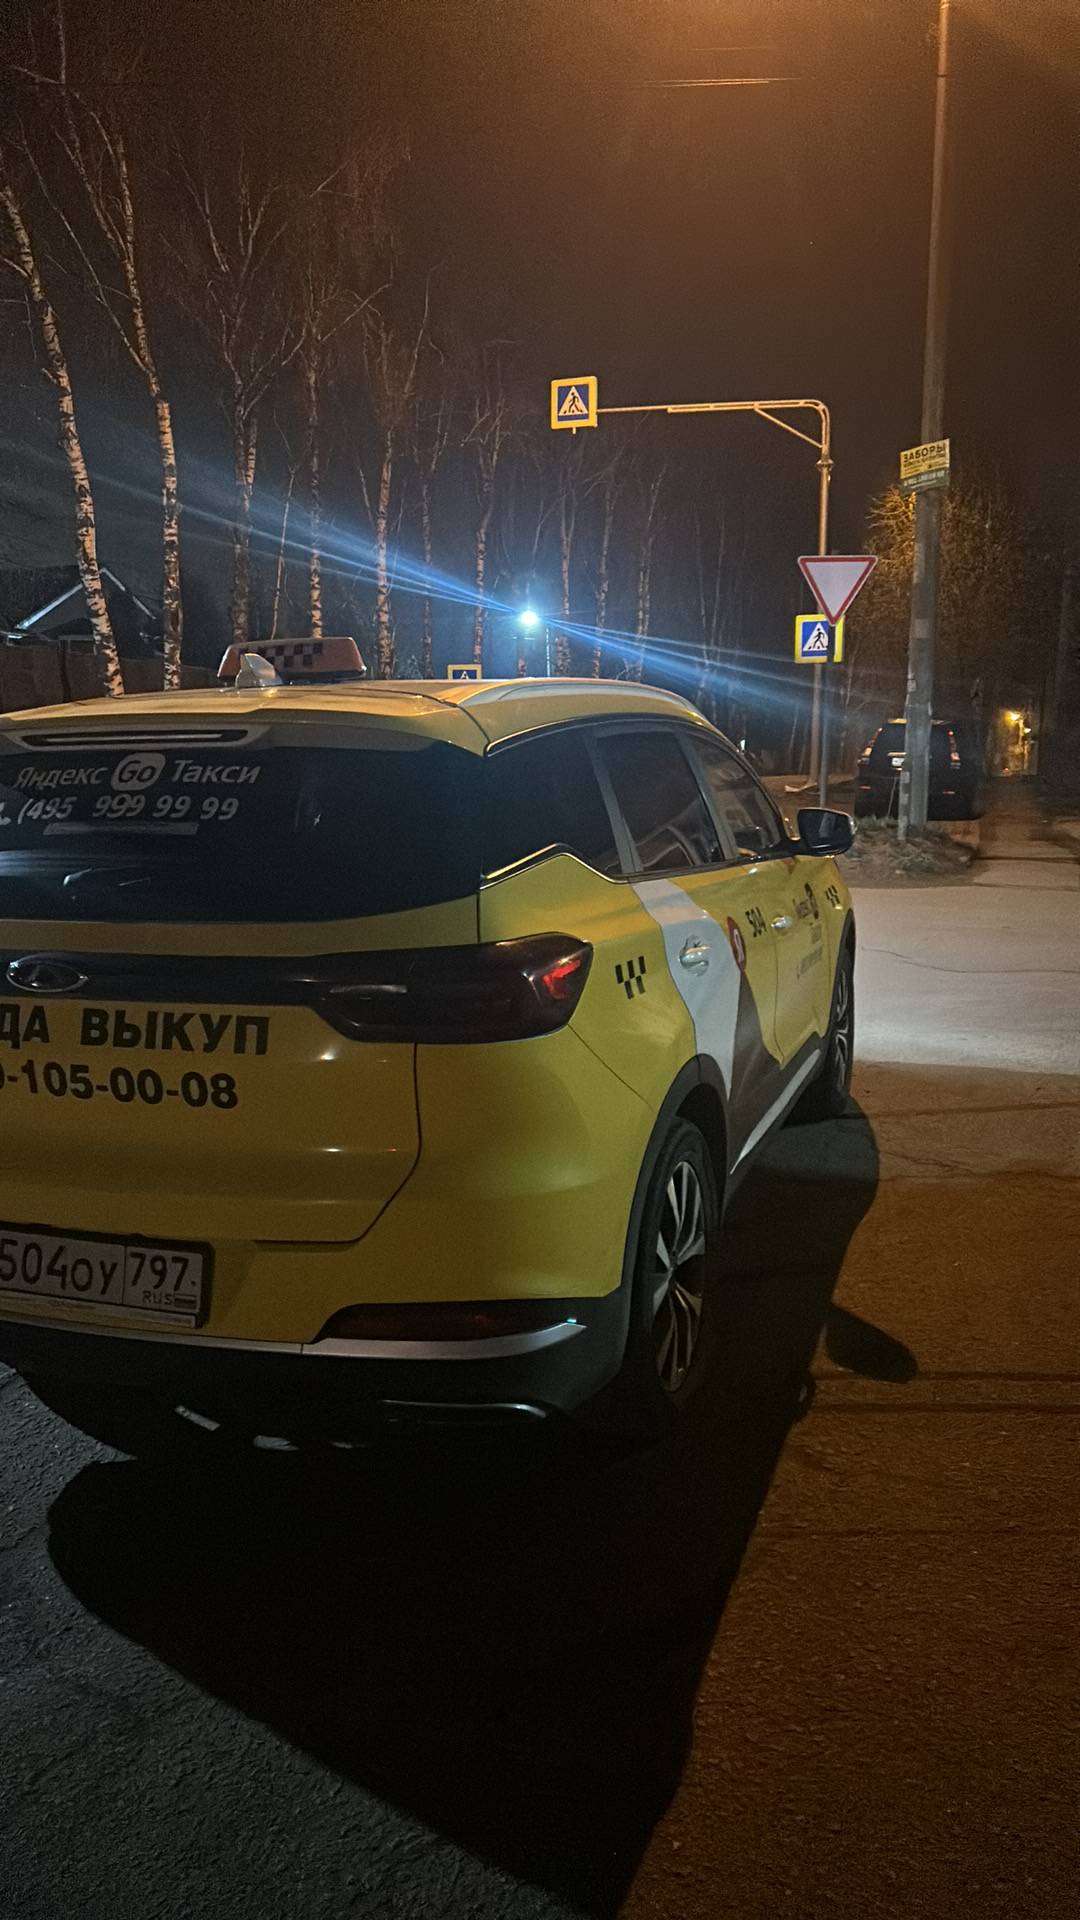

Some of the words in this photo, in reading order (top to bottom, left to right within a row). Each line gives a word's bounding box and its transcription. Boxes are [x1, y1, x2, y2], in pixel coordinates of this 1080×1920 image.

[903, 442, 946, 463] ЗАБОРЫ
[13, 766, 107, 789] Яндекс
[171, 759, 260, 783] Такси
[92, 793, 146, 818] 999
[152, 795, 192, 818] 99
[200, 796, 239, 820] 99
[80, 1007, 270, 1055] ВЫКУП
[0, 1059, 238, 1109] -105-00-08
[129, 1251, 190, 1292] 797
[142, 1290, 174, 1306] RUS
